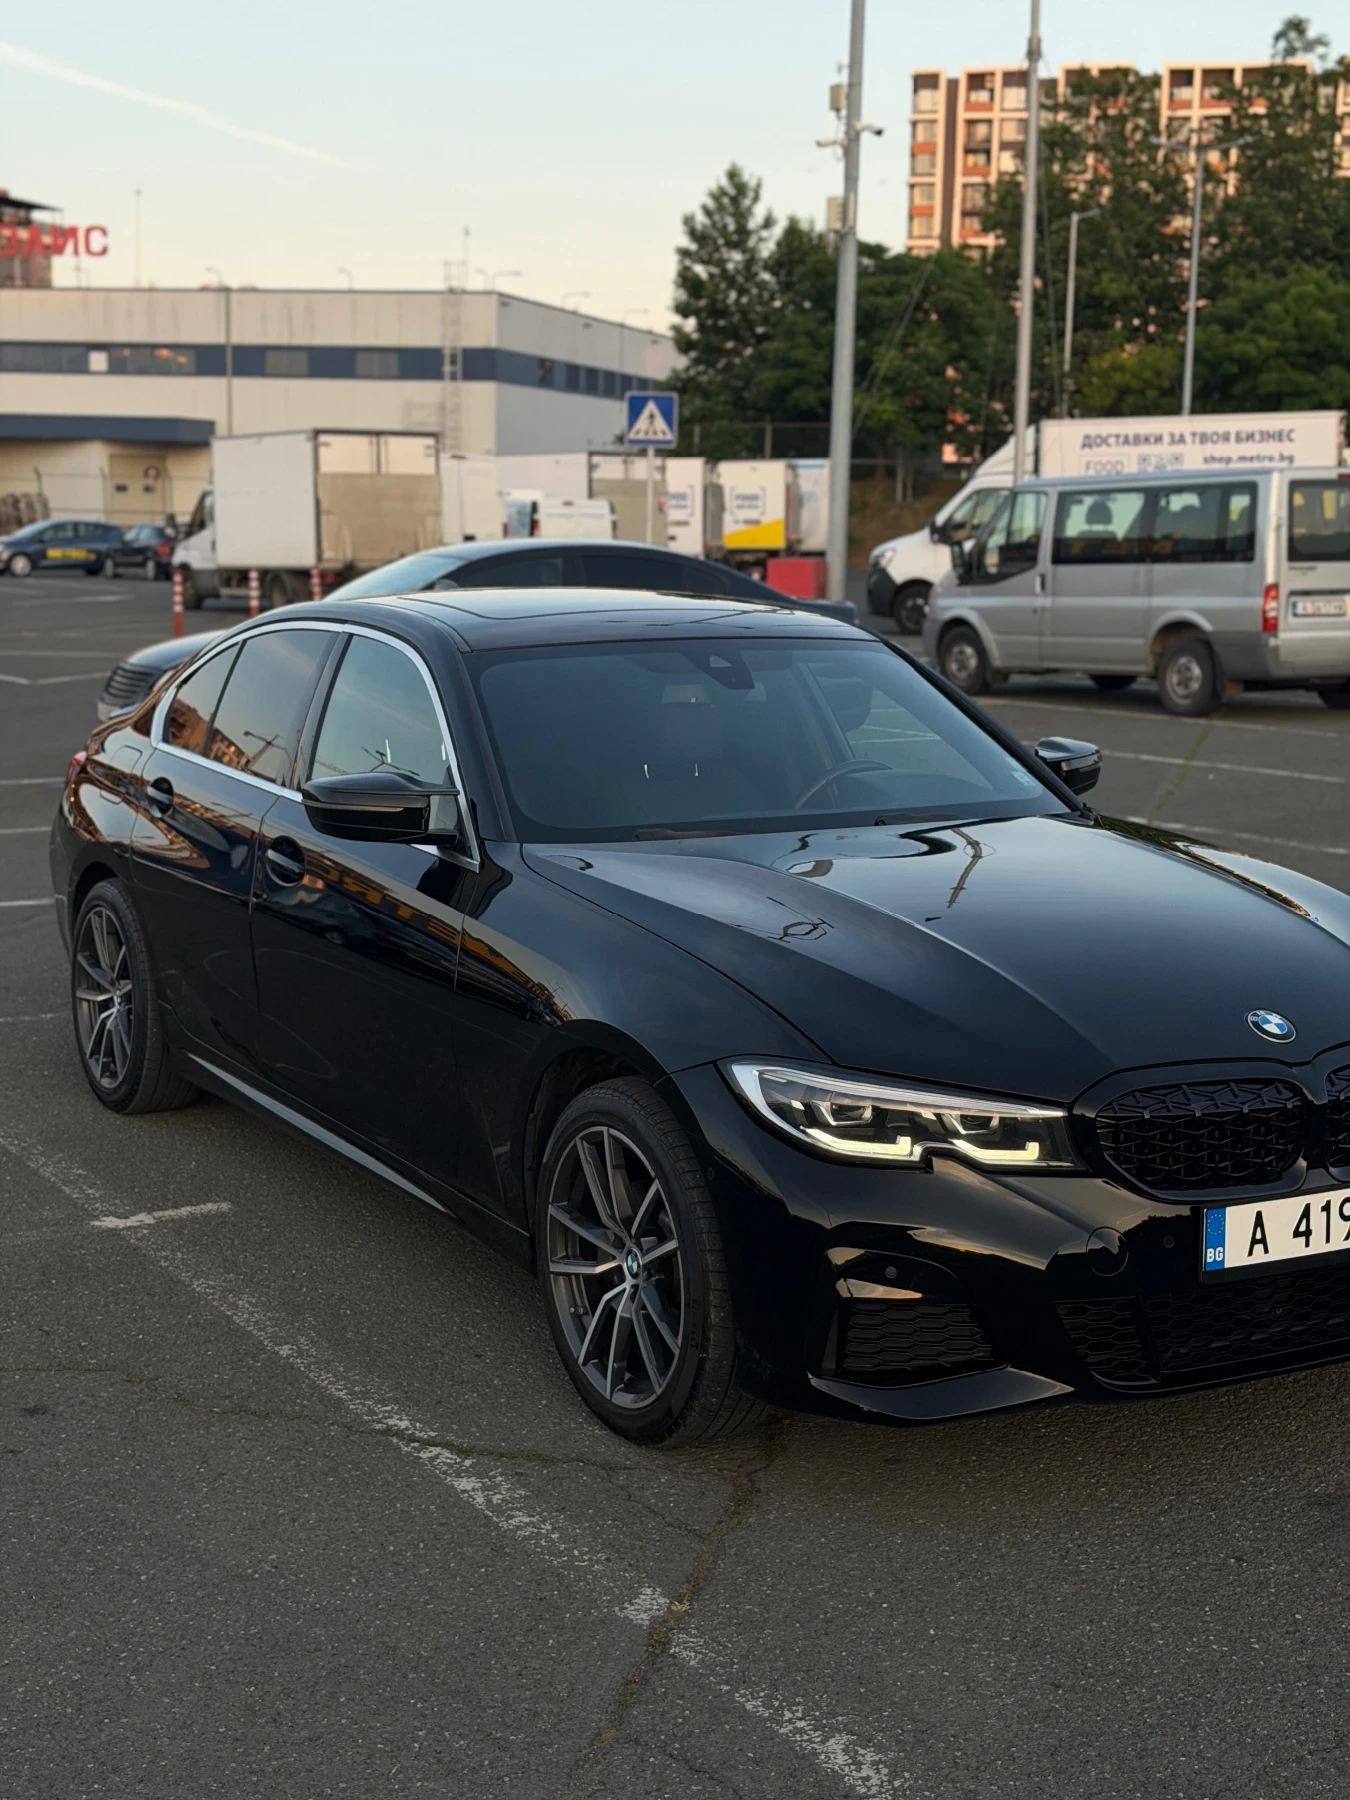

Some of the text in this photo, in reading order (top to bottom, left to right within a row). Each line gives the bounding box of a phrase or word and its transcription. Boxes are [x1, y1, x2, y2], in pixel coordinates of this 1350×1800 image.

[1081, 428, 1296, 449] ДОСТАВКИ ЗА ТВОЯ БИЗНЕС
[1084, 460, 1125, 475] FOOD
[1203, 452, 1295, 467] shop.metro.bg
[1247, 1196, 1350, 1257] A 419
[1206, 1247, 1224, 1263] BG
